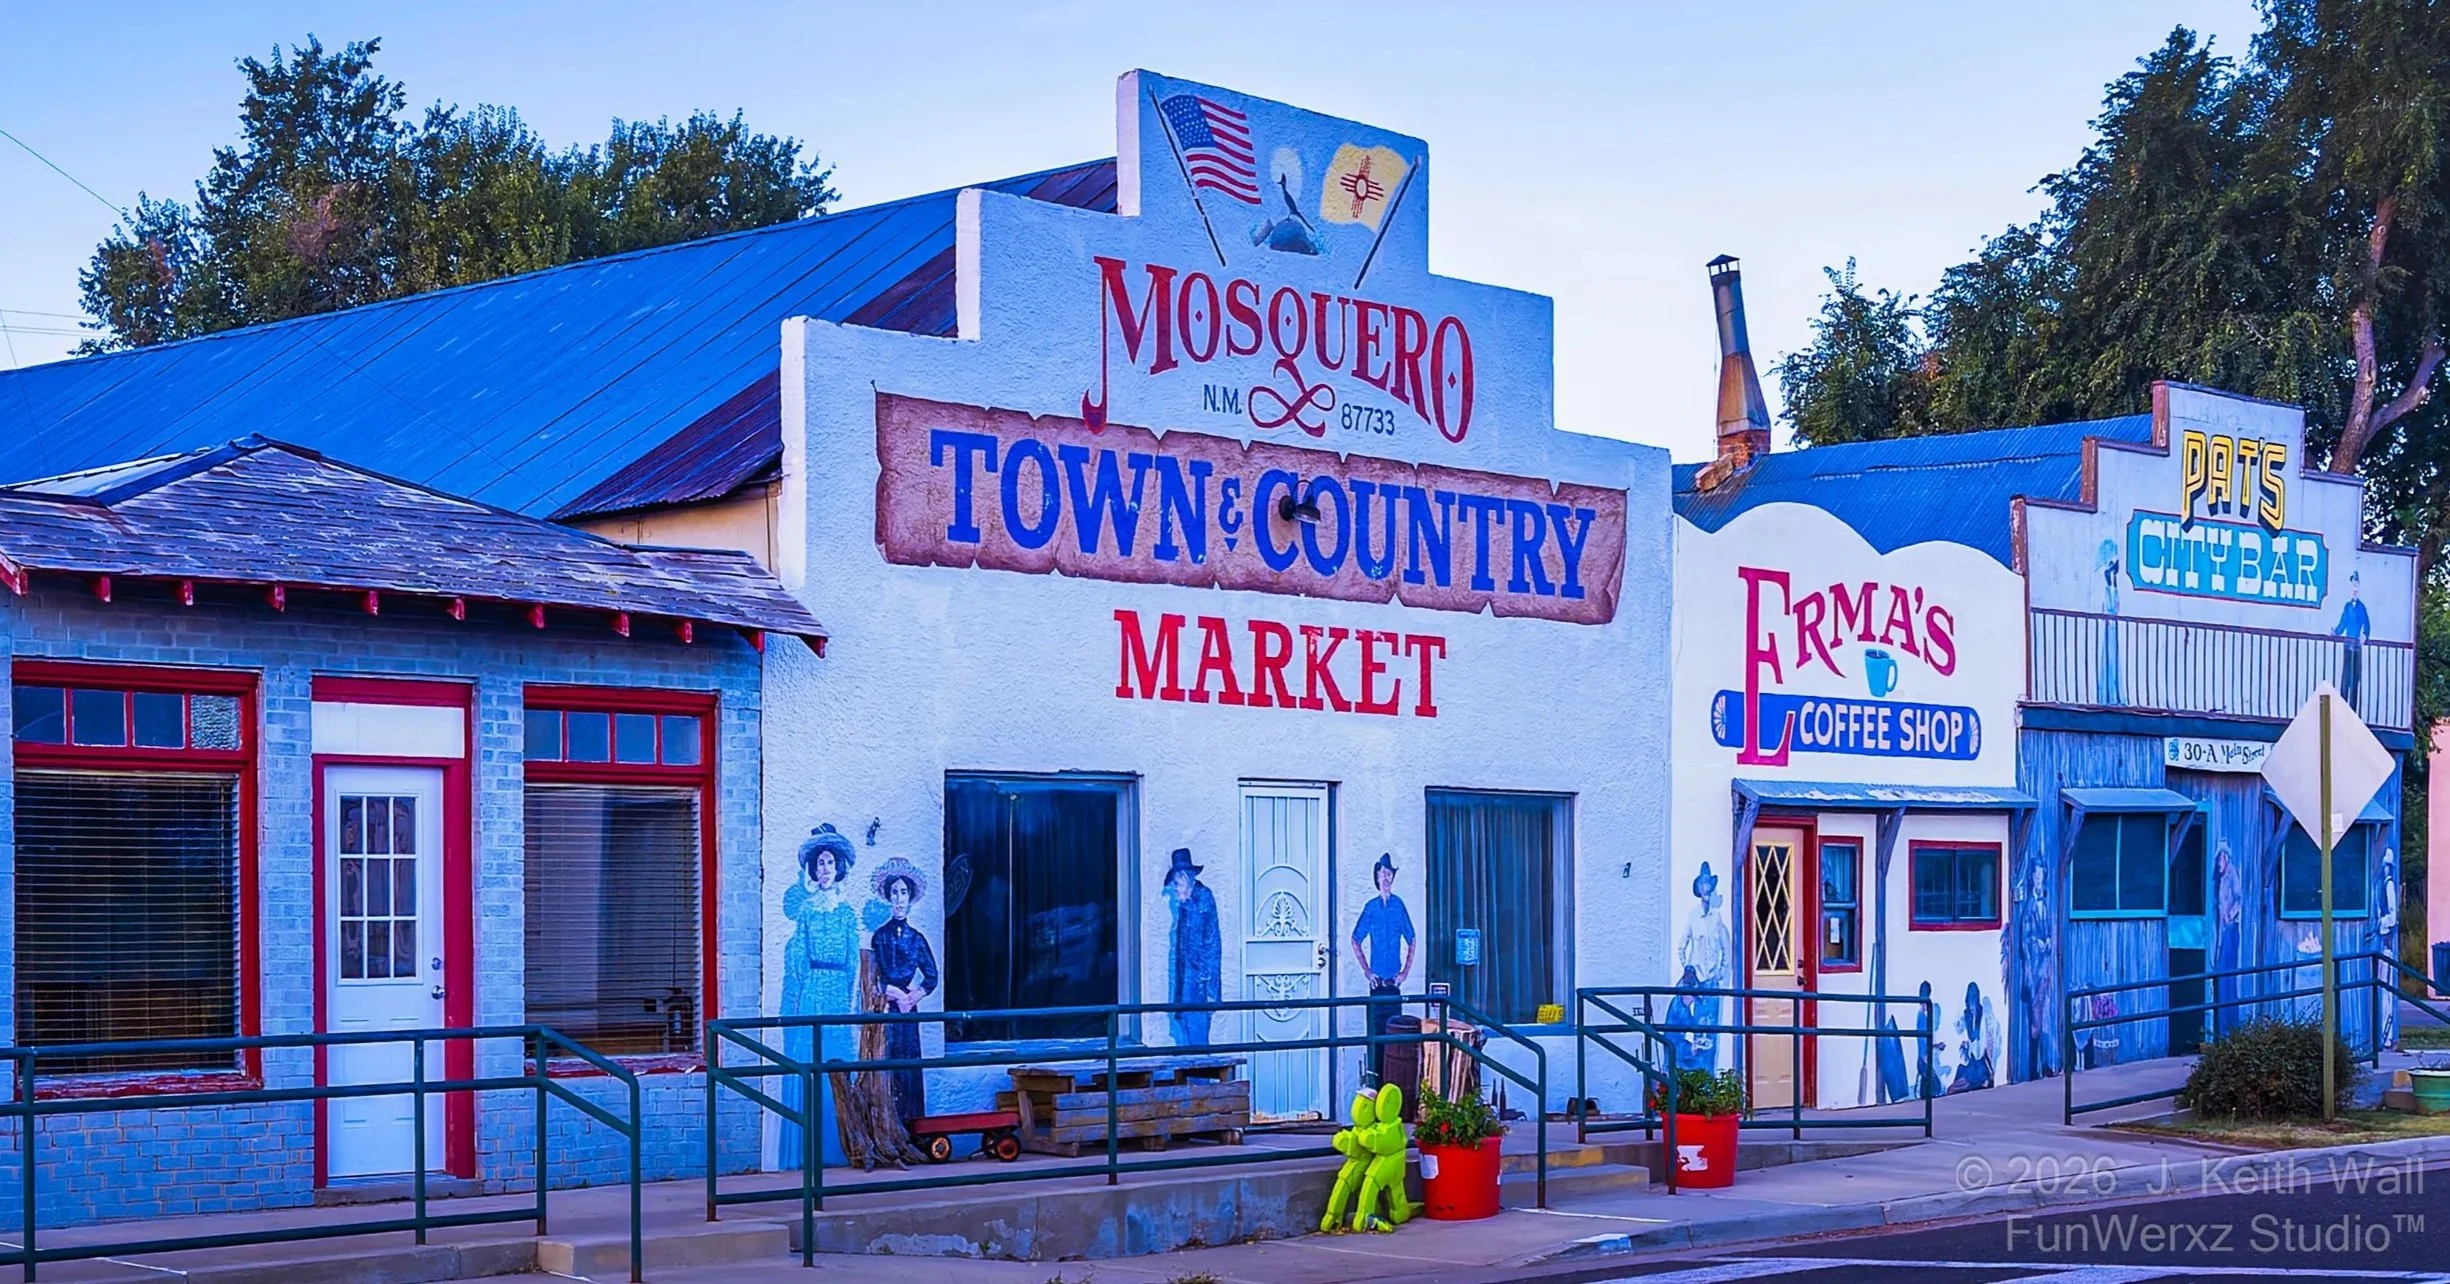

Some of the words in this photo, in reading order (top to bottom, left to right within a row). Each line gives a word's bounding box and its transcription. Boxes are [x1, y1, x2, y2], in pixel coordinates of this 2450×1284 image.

[1081, 256, 1474, 444] MOSQUERO
[1203, 383, 1243, 415] N.M.
[1340, 402, 1396, 435] 87733
[930, 429, 1212, 563] TOWN
[1218, 477, 1243, 544] &
[1252, 468, 1596, 599] COUNTRY
[2181, 429, 2287, 538] PAT'S
[2138, 518, 2232, 593] CITY
[2236, 531, 2319, 602] BAR
[1113, 609, 1447, 718] MARKET
[1736, 566, 1956, 768] ERMA'S
[1799, 701, 1892, 750] COFFEE
[1899, 708, 1963, 753] SHOP
